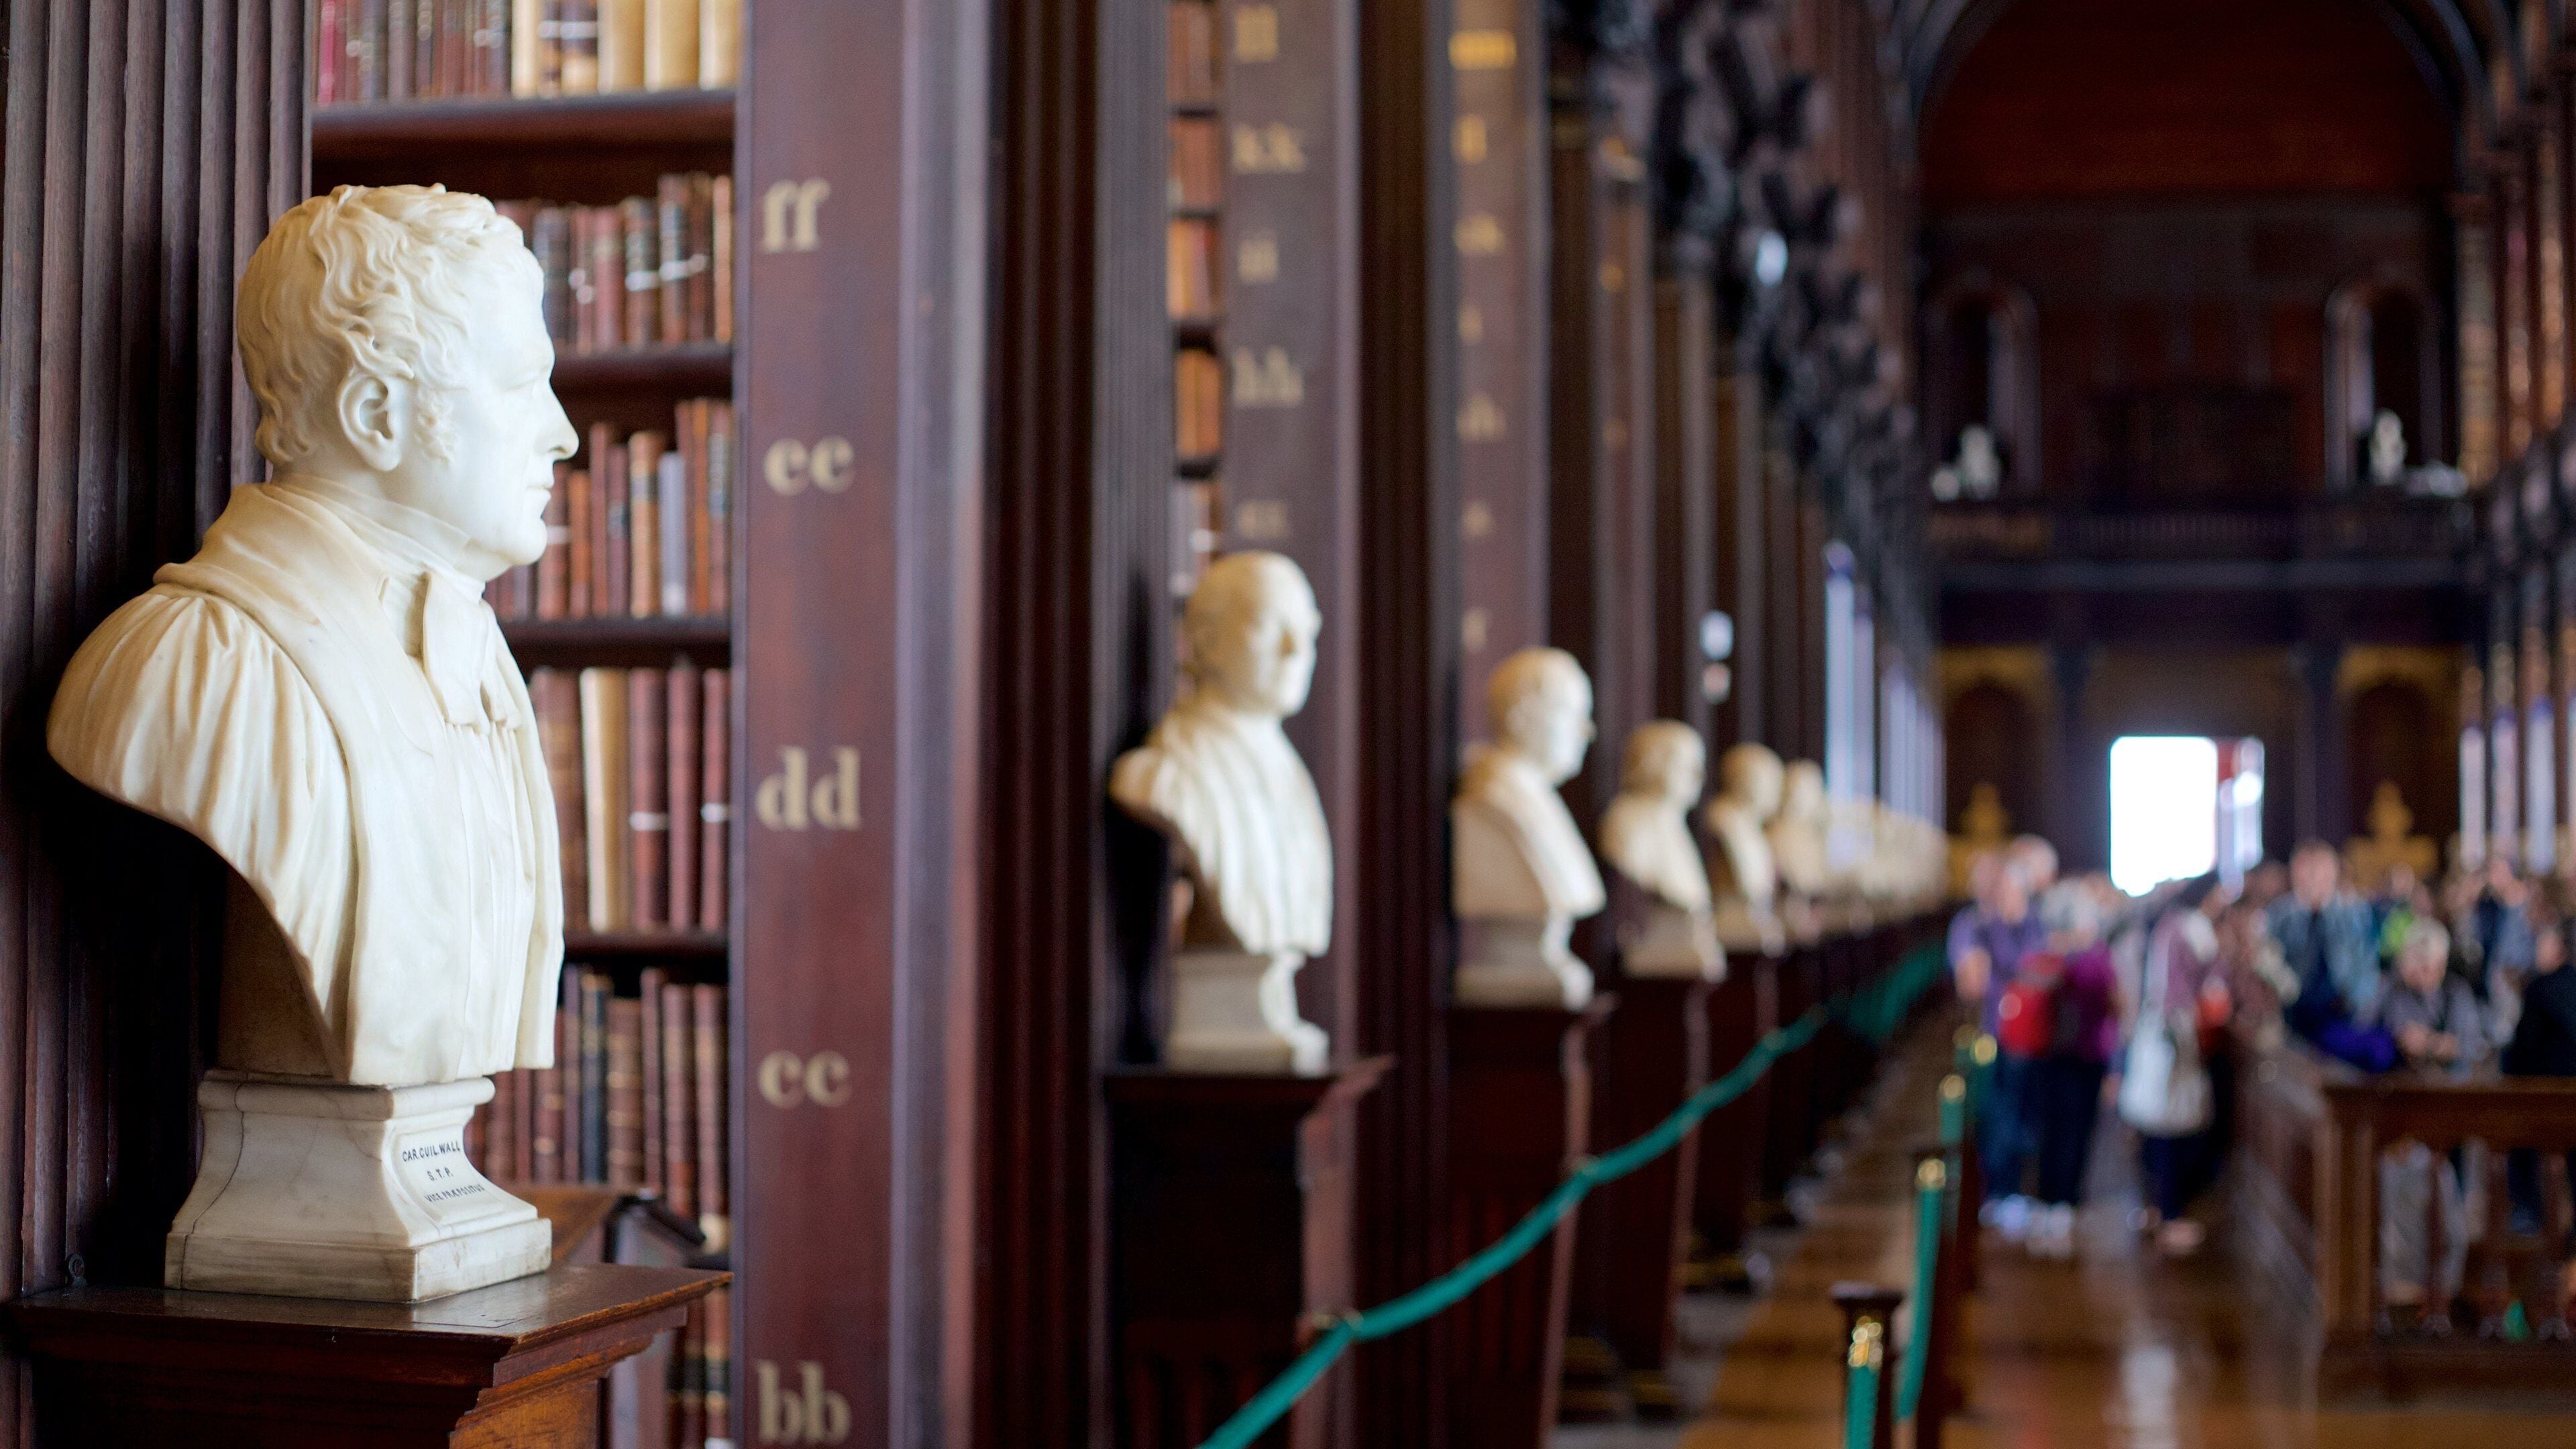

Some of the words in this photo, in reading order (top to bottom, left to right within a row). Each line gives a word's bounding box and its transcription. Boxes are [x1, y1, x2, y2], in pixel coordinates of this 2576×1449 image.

[763, 178, 830, 252] ff
[756, 746, 861, 830] dd
[758, 1051, 852, 1108] cc
[755, 1358, 851, 1444] bb
